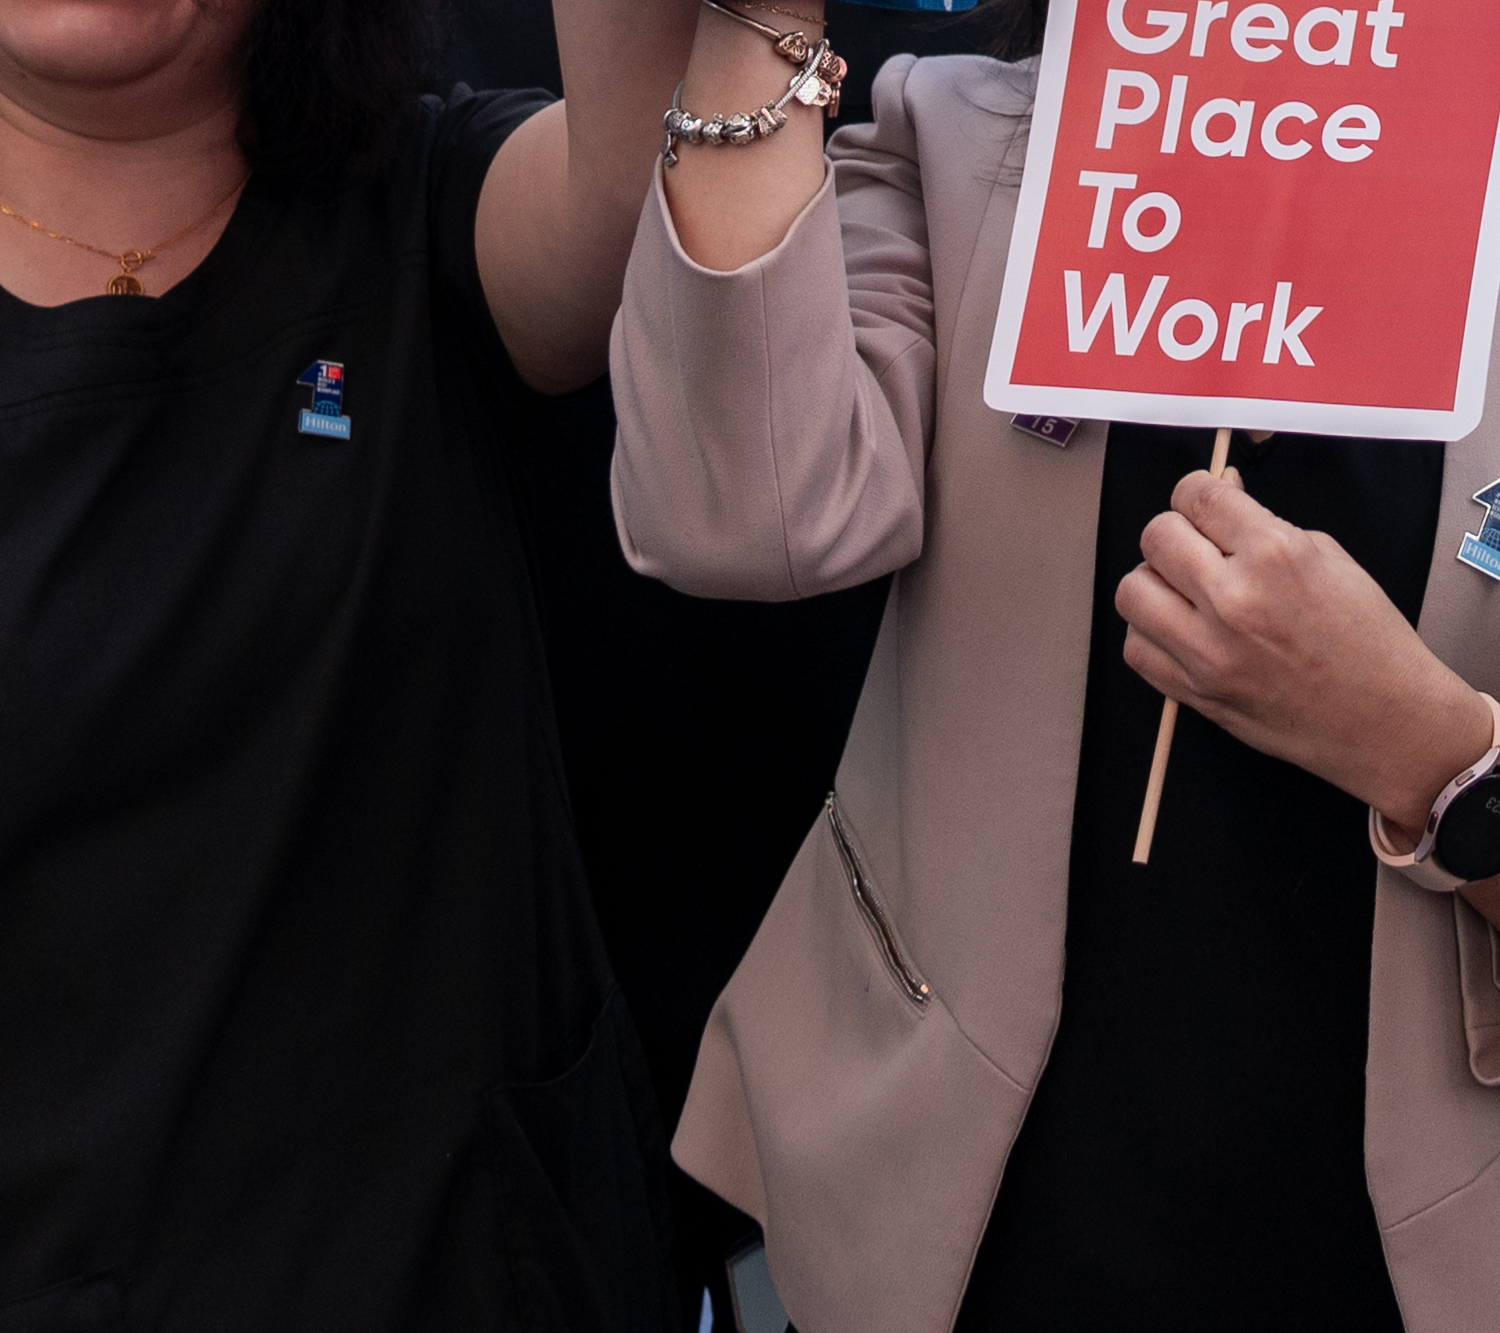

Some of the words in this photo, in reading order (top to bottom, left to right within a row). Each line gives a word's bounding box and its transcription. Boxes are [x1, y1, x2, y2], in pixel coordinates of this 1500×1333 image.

[1094, 68, 1382, 164] Place
[1077, 170, 1182, 253] To
[1062, 268, 1324, 368] Work
[304, 415, 347, 432] Hilton
